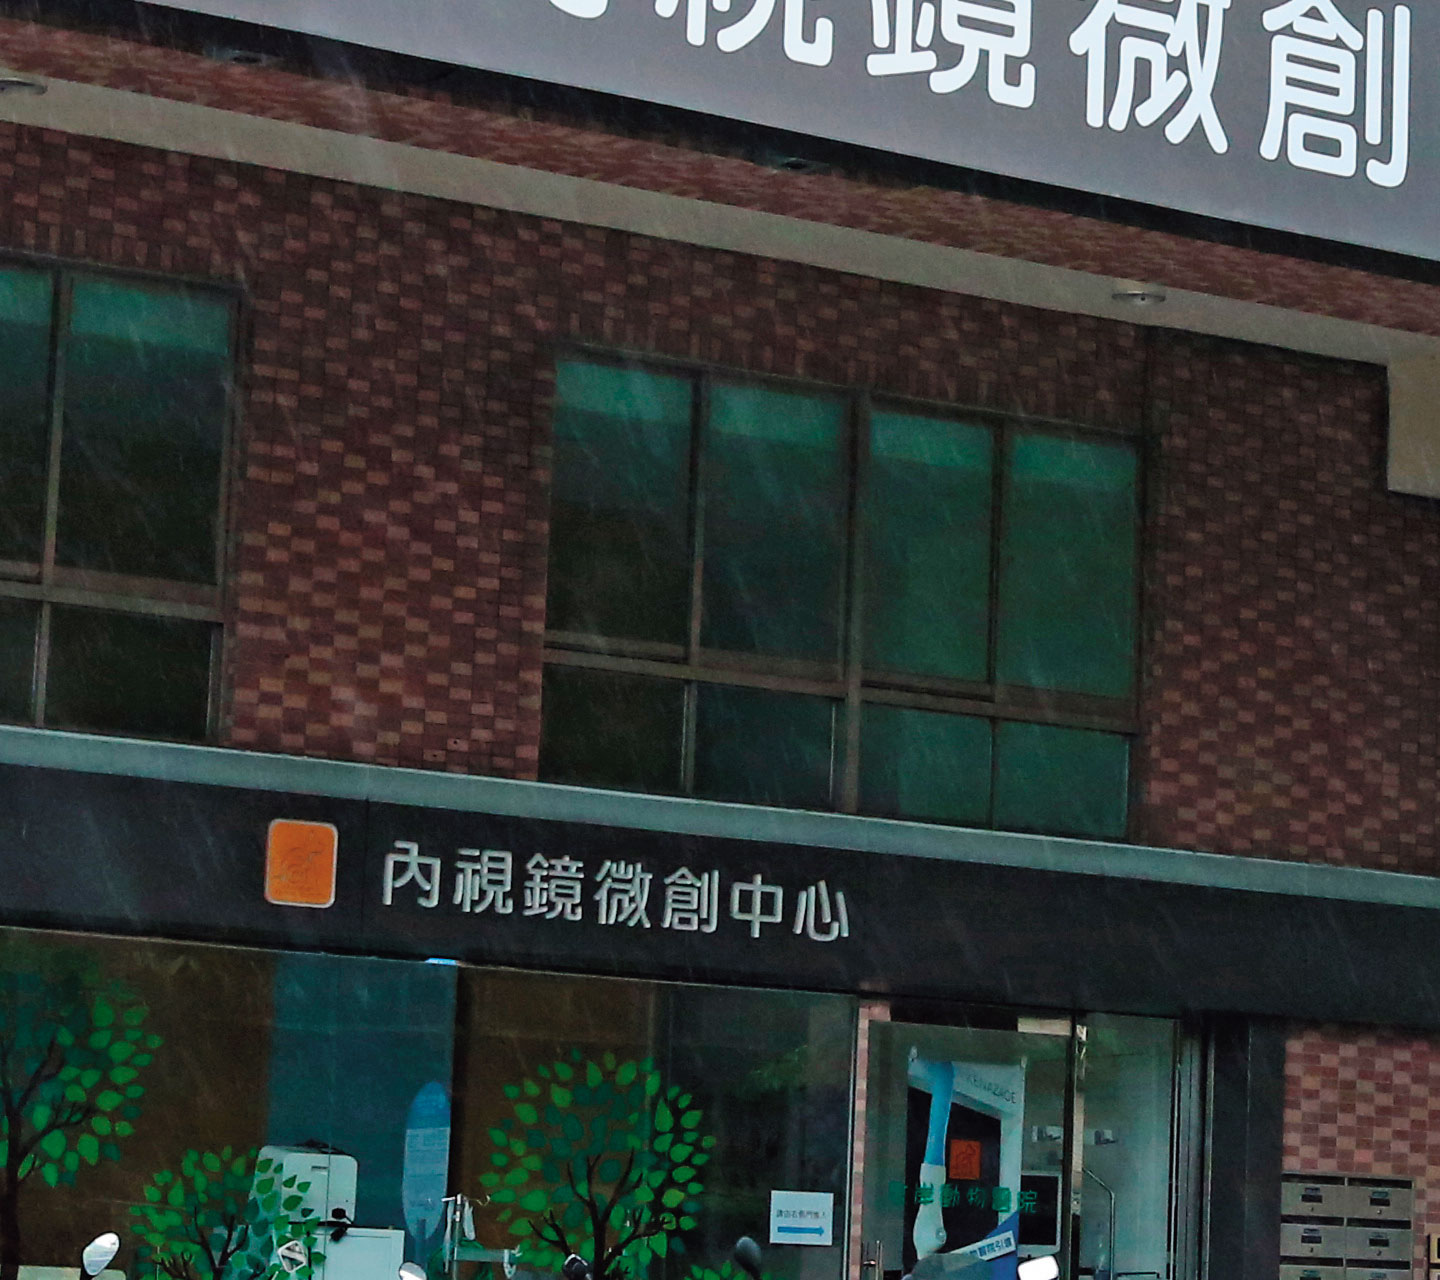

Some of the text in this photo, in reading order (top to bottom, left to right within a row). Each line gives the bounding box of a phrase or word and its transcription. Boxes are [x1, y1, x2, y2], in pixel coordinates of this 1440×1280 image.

[382, 839, 850, 943] 內視鏡微創中心
